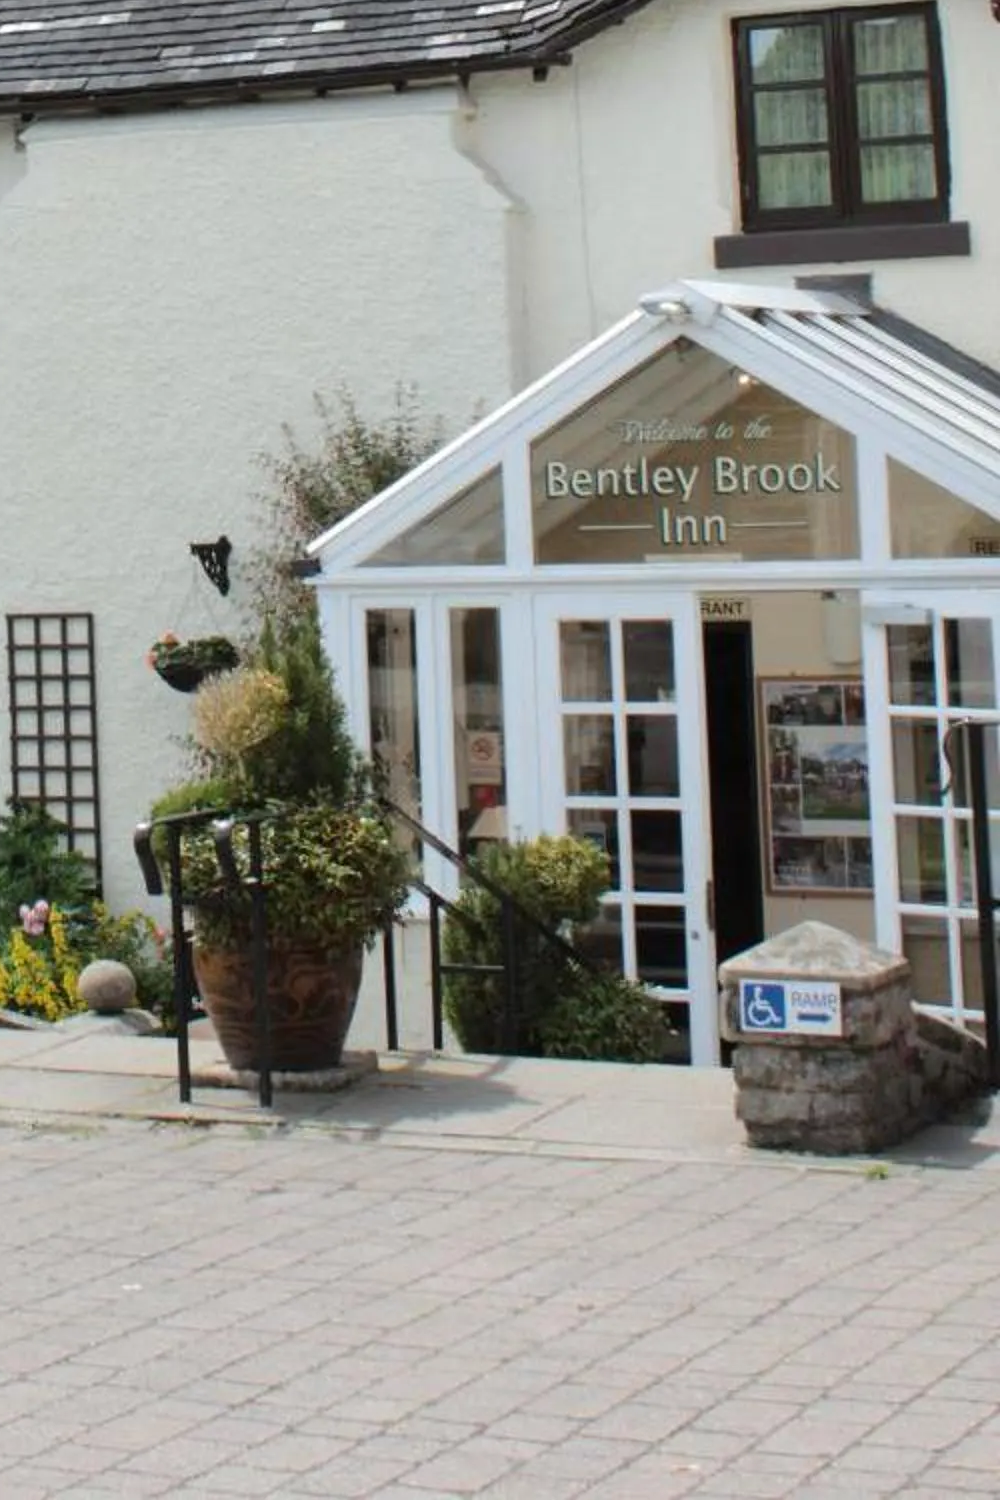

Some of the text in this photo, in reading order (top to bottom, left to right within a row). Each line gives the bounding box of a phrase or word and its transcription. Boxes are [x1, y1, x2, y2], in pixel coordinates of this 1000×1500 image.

[714, 421, 734, 440] to
[743, 414, 772, 440] the
[546, 452, 841, 501] Bentley Brook
[660, 508, 728, 546] Inn
[791, 991, 837, 1009] RAMP
